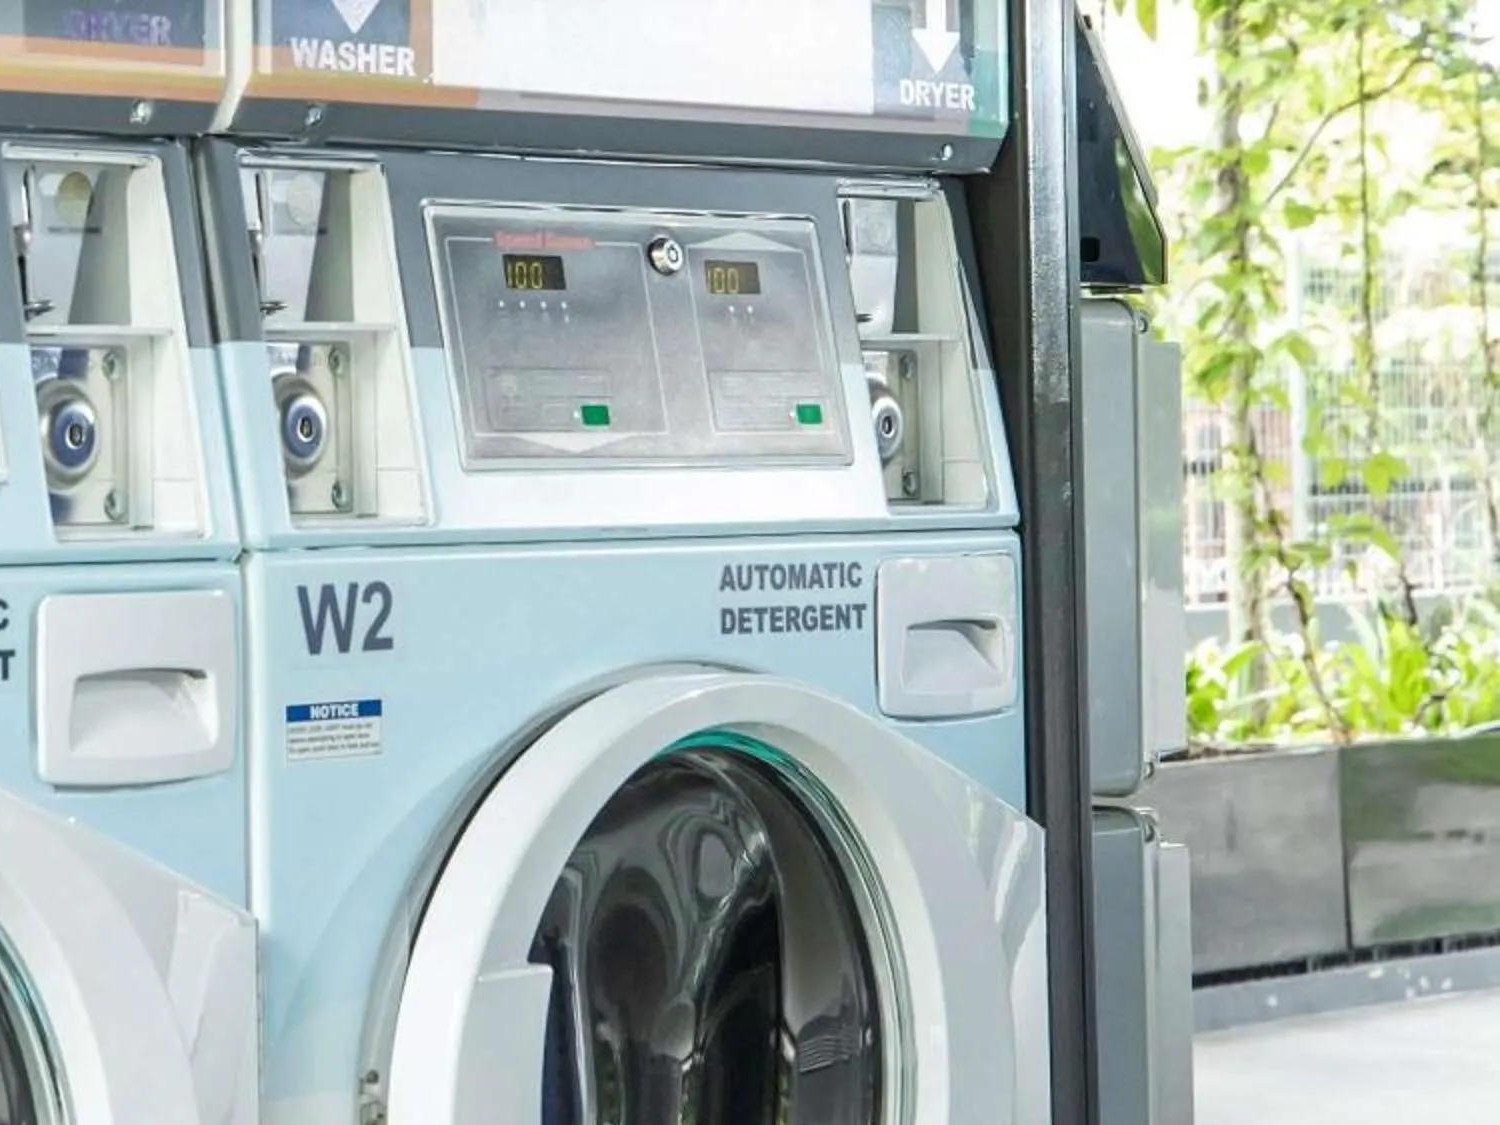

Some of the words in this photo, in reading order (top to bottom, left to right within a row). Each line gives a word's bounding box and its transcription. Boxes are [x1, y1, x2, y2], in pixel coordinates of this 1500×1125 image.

[290, 36, 416, 77] WASHER
[899, 79, 976, 111] DRYER
[507, 261, 542, 289] 100
[719, 561, 863, 592] AUTOMATIC
[296, 580, 394, 655] W2
[720, 603, 867, 635] DETERGENT
[310, 704, 359, 719] NOTICE
